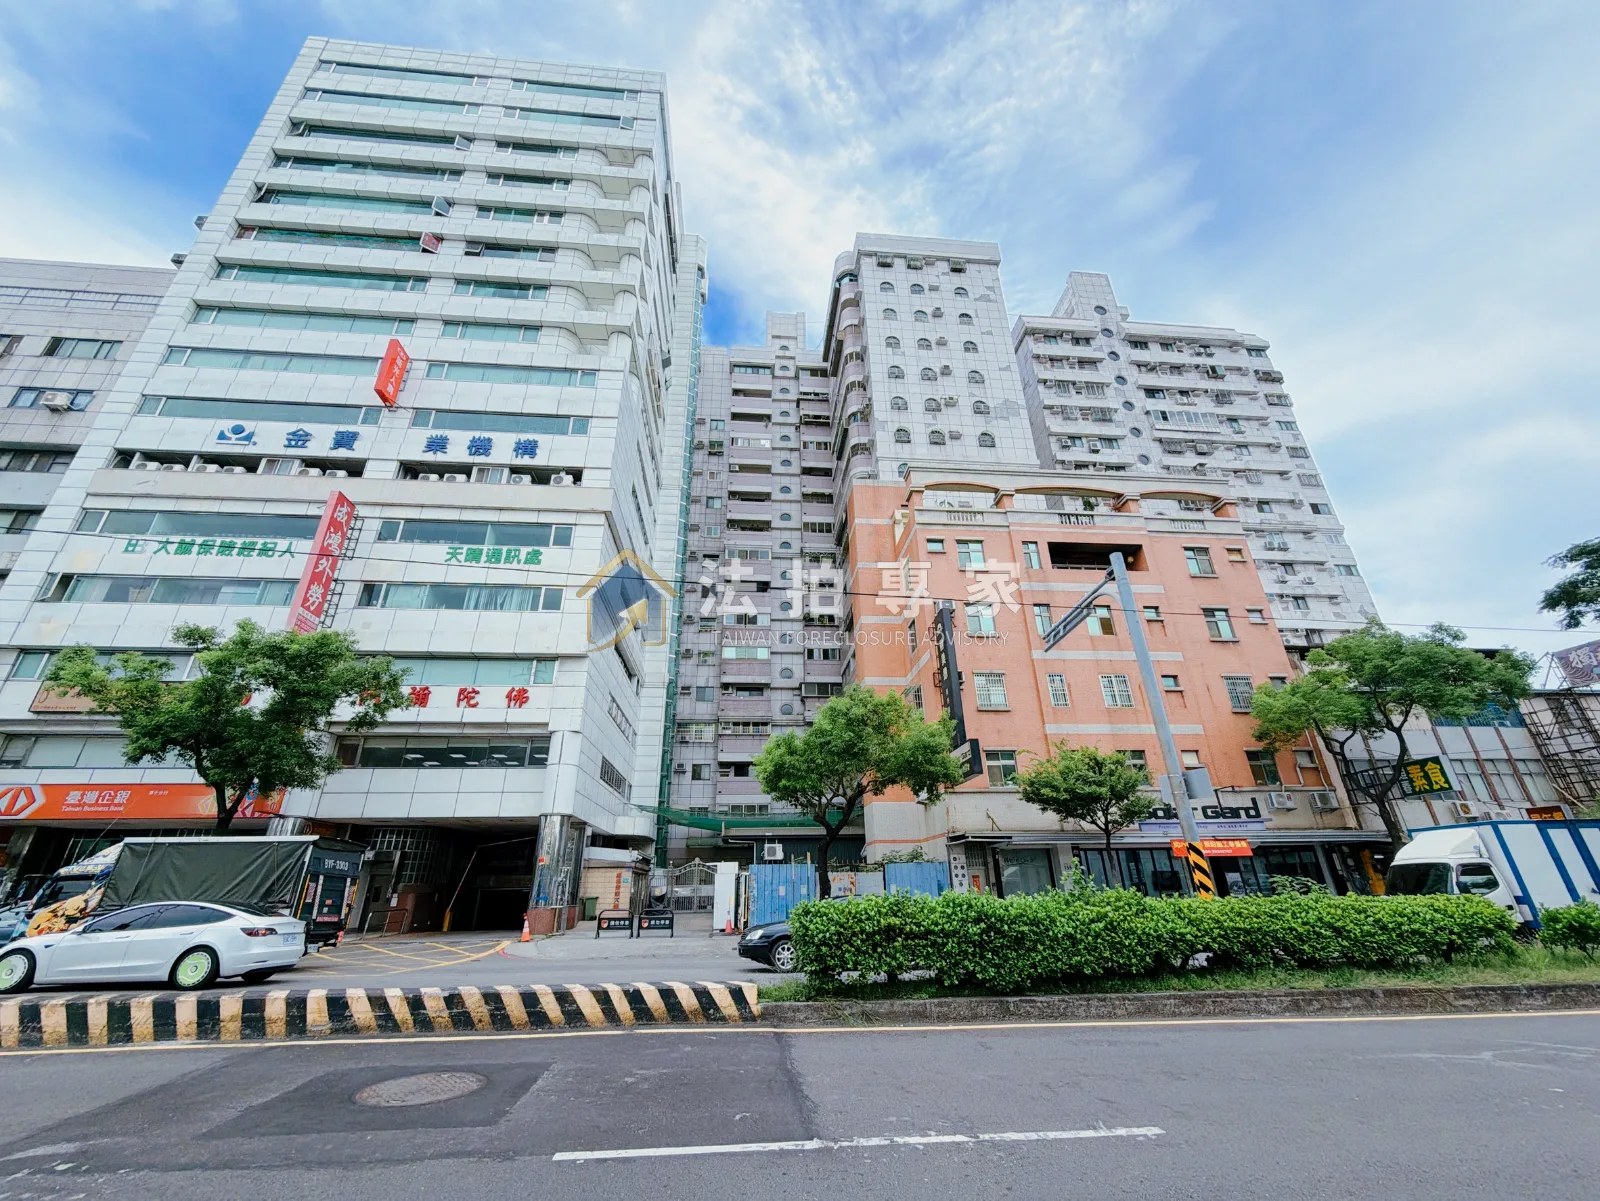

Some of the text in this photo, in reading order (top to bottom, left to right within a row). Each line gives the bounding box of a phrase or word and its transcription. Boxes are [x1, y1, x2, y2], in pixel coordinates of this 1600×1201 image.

[283, 427, 540, 459] 金寶 業機構
[152, 537, 296, 559] 大誠保險經紀人
[304, 502, 351, 611] 成鴻外勞
[1406, 761, 1449, 792] 素食
[64, 790, 131, 804] 臺灣企銀
[1201, 797, 1262, 819] Gard
